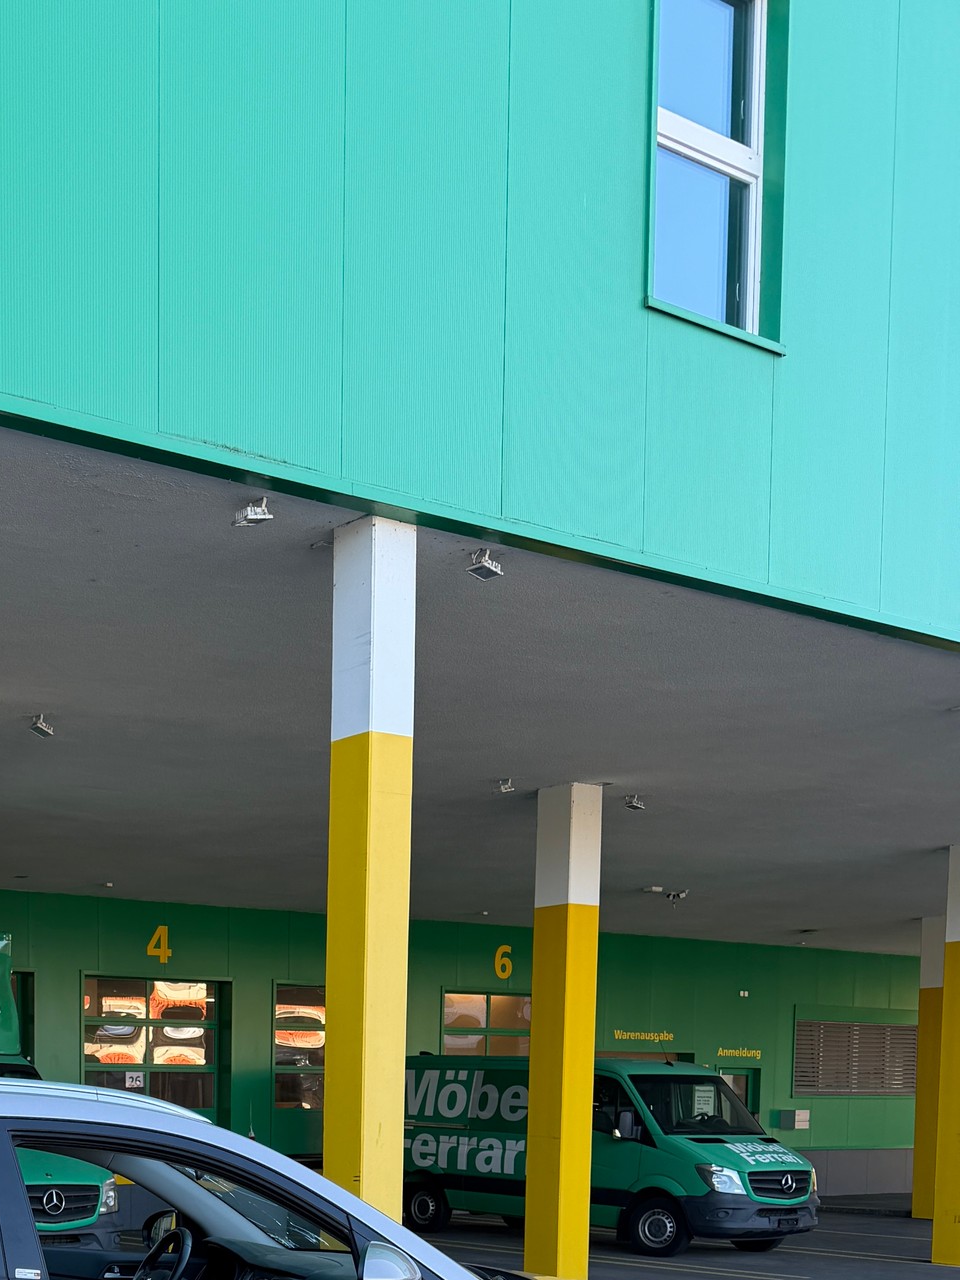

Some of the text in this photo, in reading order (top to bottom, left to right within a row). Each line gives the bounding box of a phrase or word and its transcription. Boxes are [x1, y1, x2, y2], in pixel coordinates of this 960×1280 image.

[147, 925, 172, 964] 4
[494, 944, 513, 980] 6
[614, 1029, 674, 1042] Warenausgabe
[717, 1047, 761, 1060] Anmeldung
[405, 1069, 529, 1121] Möbe
[403, 1120, 527, 1175] errar
[724, 1143, 792, 1156] Möbel
[740, 1151, 803, 1165] Ferrari
